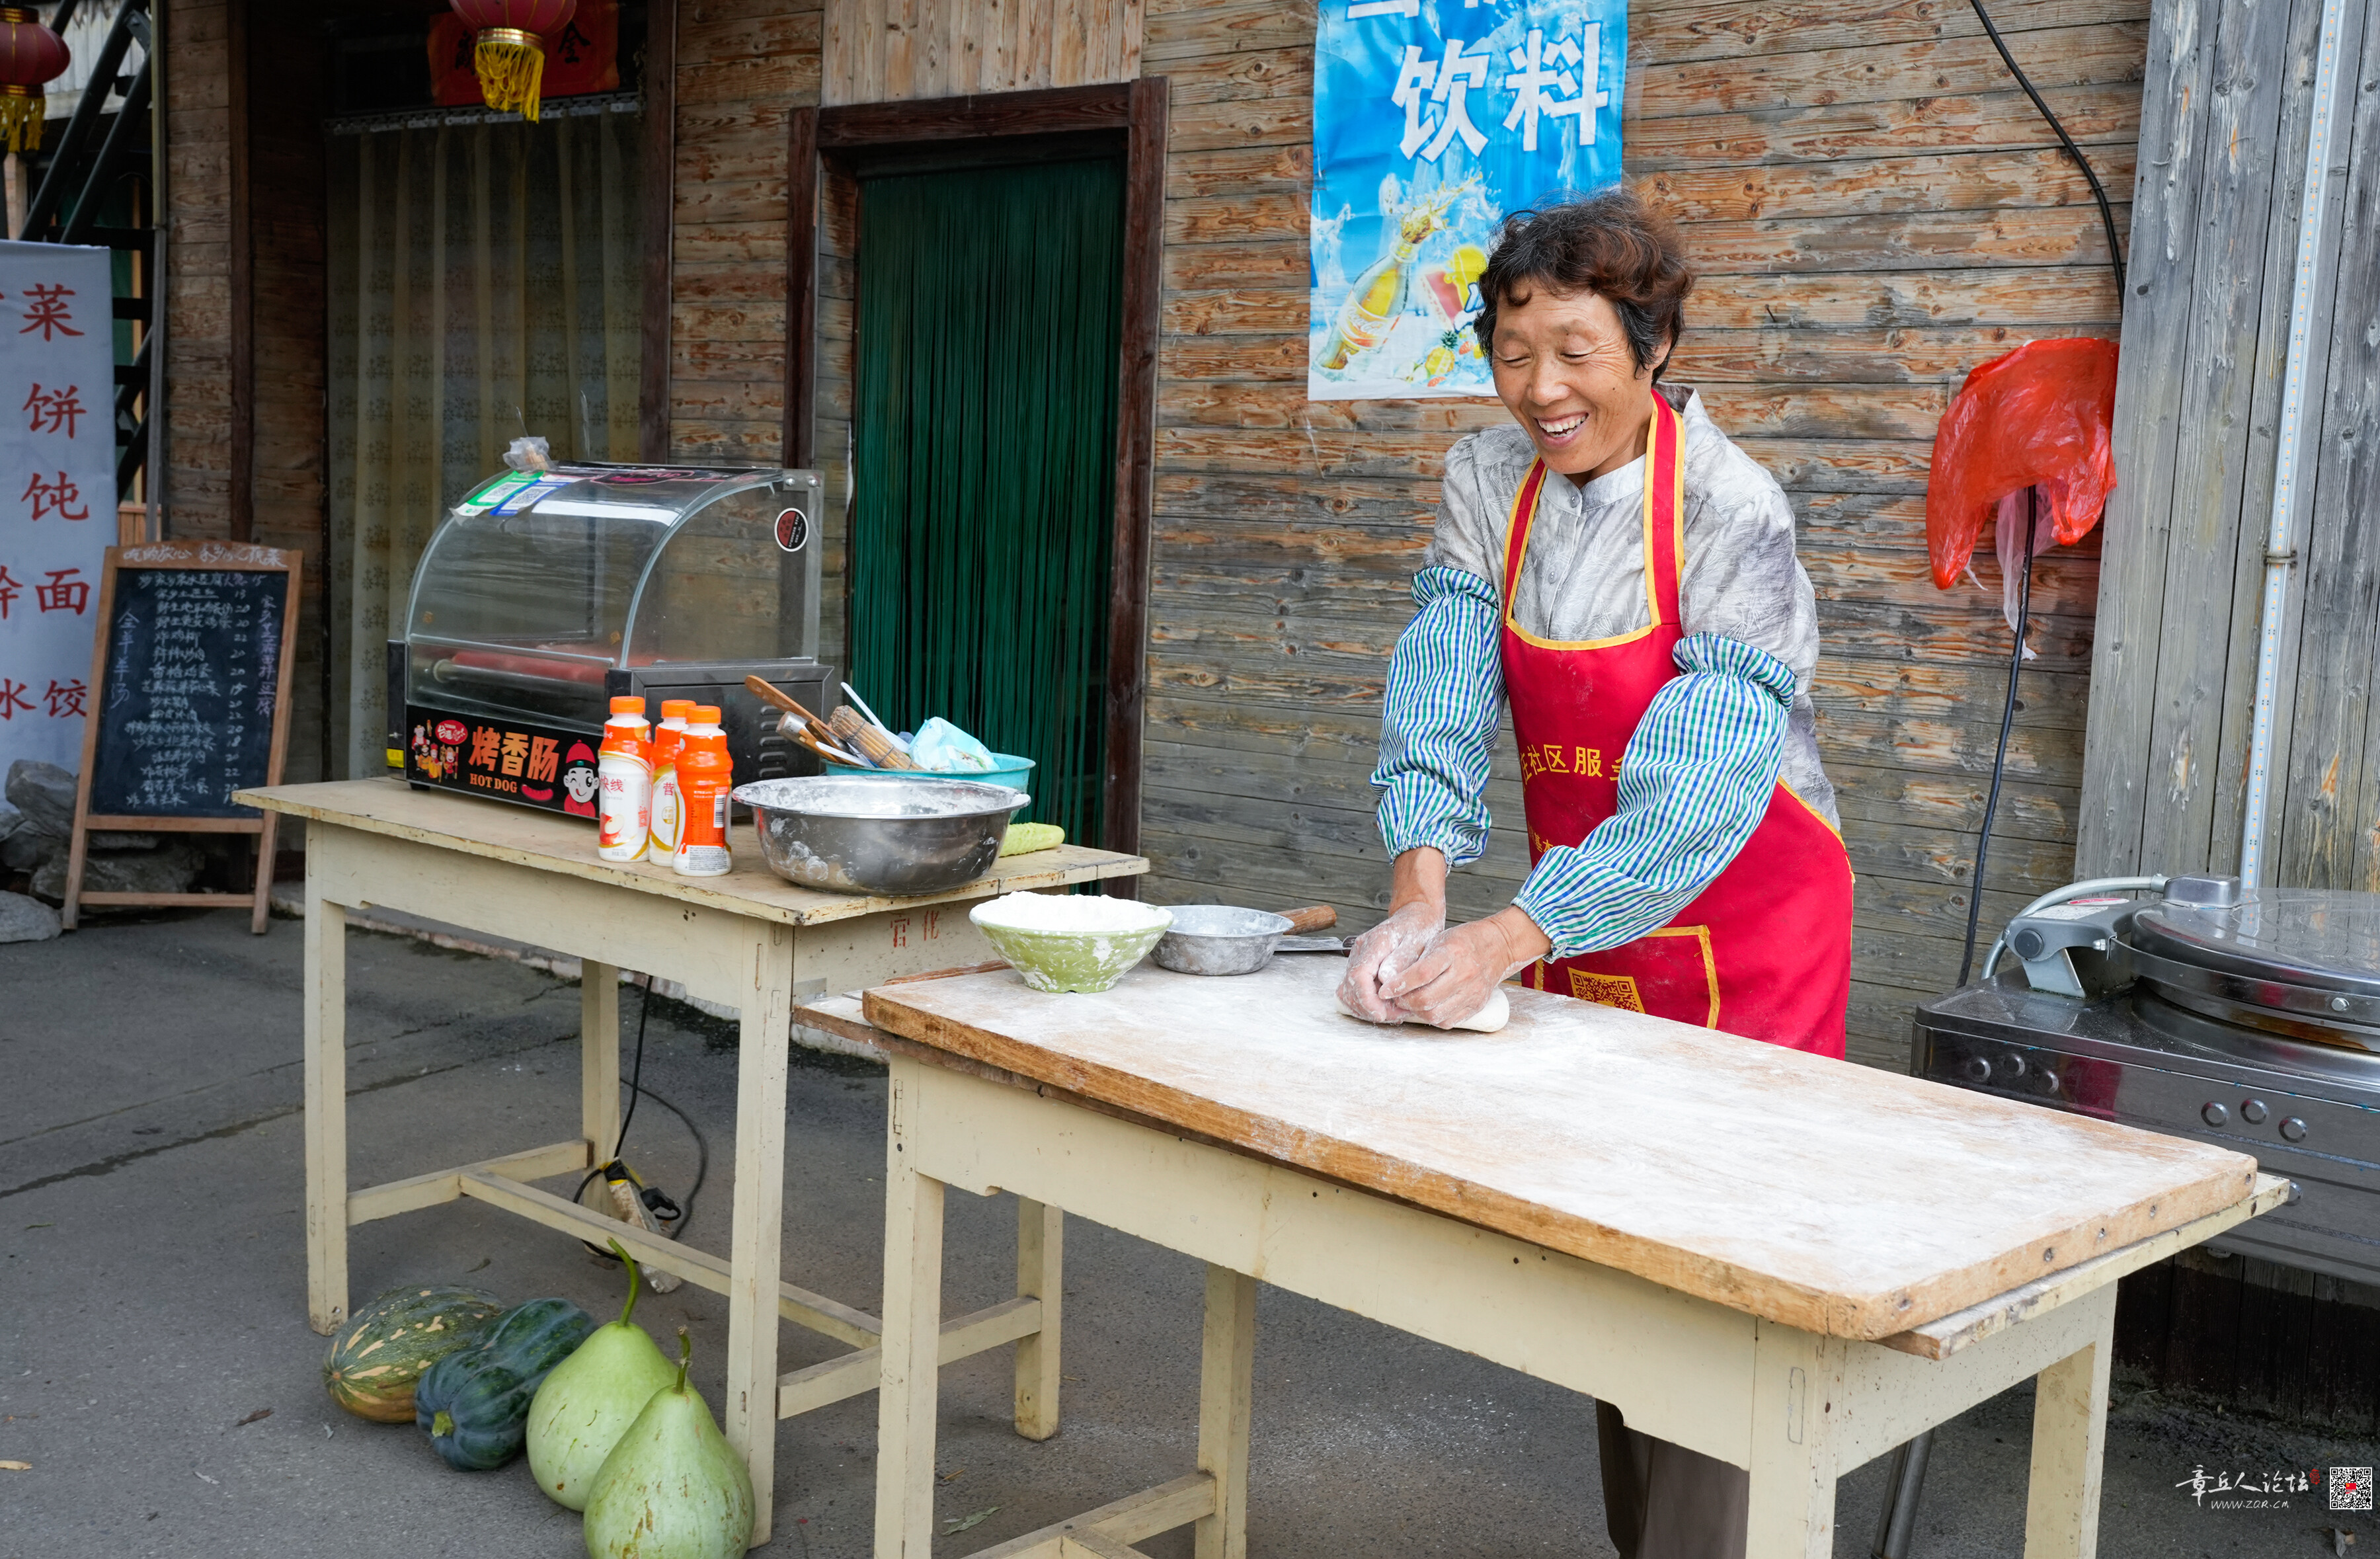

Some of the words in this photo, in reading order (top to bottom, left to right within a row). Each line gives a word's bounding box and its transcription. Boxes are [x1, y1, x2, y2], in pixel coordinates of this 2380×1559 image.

[1392, 22, 1608, 163] 饮料
[19, 284, 85, 342] 菜
[22, 383, 87, 439] 饼
[21, 471, 89, 521] 饨
[0, 678, 87, 721] 水饺
[225, 768, 241, 777] 22
[468, 725, 560, 783] 烤香肠
[469, 773, 491, 788] HOT
[494, 777, 518, 793] DOG
